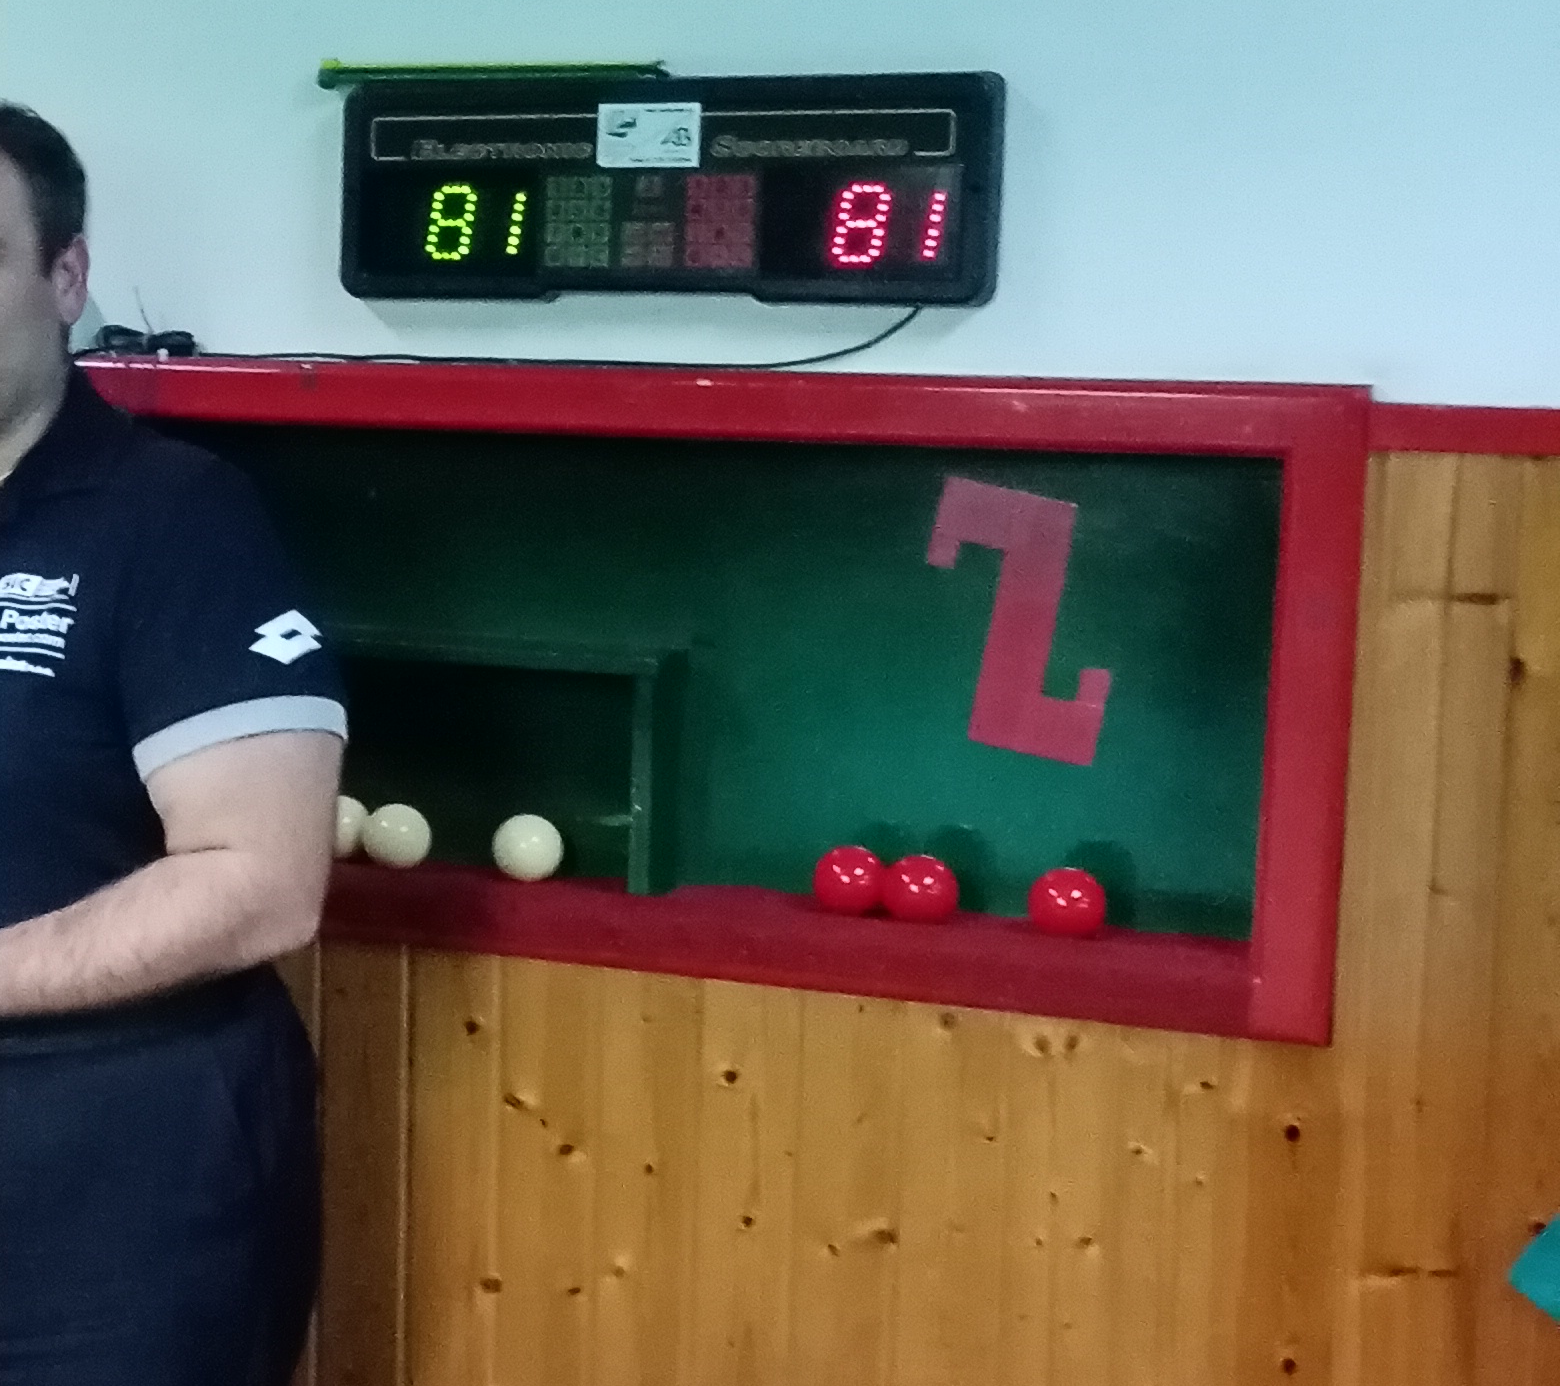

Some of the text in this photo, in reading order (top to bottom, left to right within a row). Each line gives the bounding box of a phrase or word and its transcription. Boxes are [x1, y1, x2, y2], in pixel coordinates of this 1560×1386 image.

[424, 183, 528, 262] 81
[829, 183, 948, 266] 81
[0, 608, 75, 634] Poster
